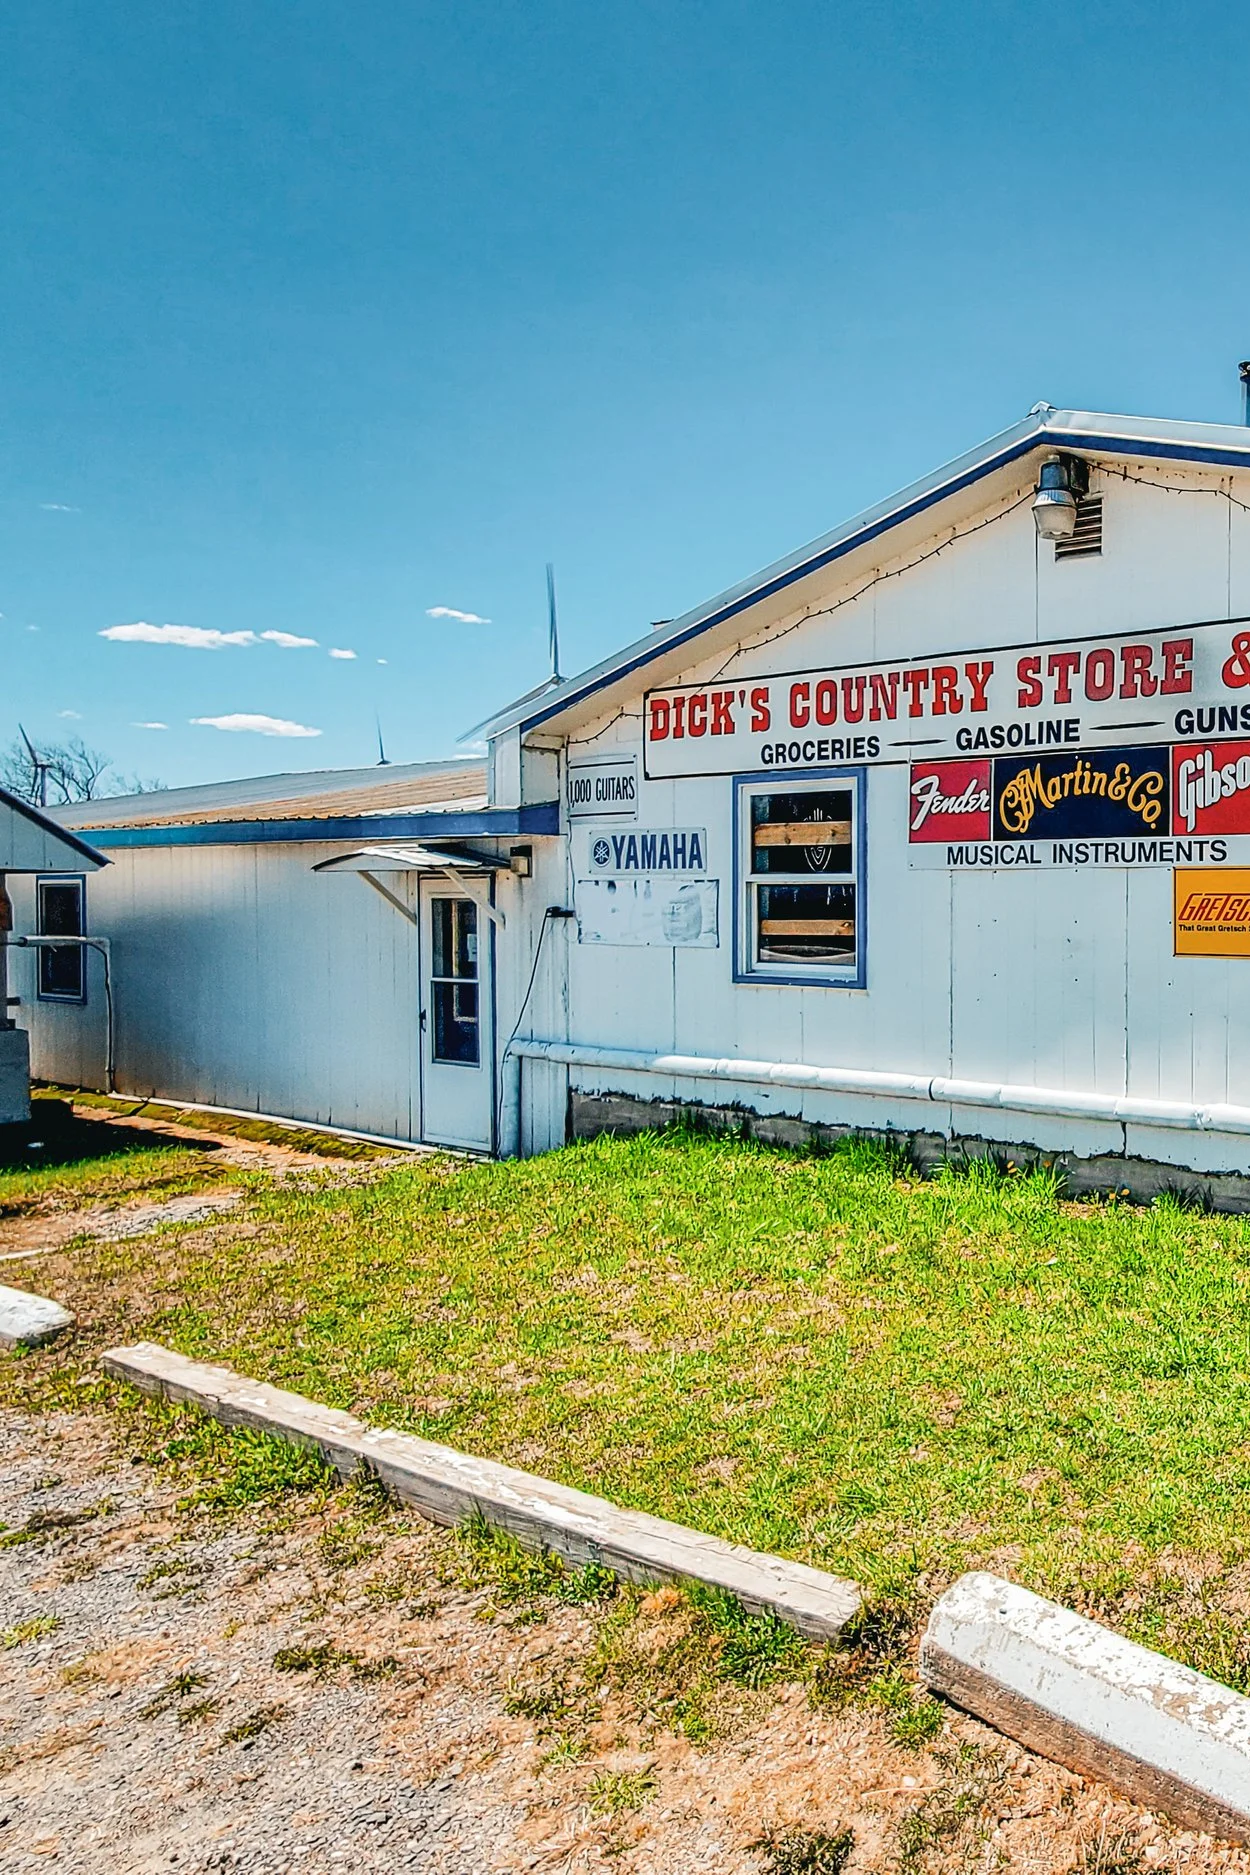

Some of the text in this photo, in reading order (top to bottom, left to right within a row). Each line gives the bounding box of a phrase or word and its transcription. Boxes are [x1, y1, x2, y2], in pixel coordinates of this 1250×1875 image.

[649, 687, 771, 741] DICK'S
[789, 661, 994, 728] COUNTRY
[1017, 638, 1194, 709] STORE
[761, 735, 880, 764] GROCERIES
[956, 718, 1080, 751] GASOLINE
[570, 776, 635, 808] 1,000 GUITARS
[911, 775, 990, 830] Fender
[611, 833, 703, 869] YAMAHA
[947, 840, 1227, 865] MUSICAL INSTRUMENTS
[1179, 924, 1195, 932] That
